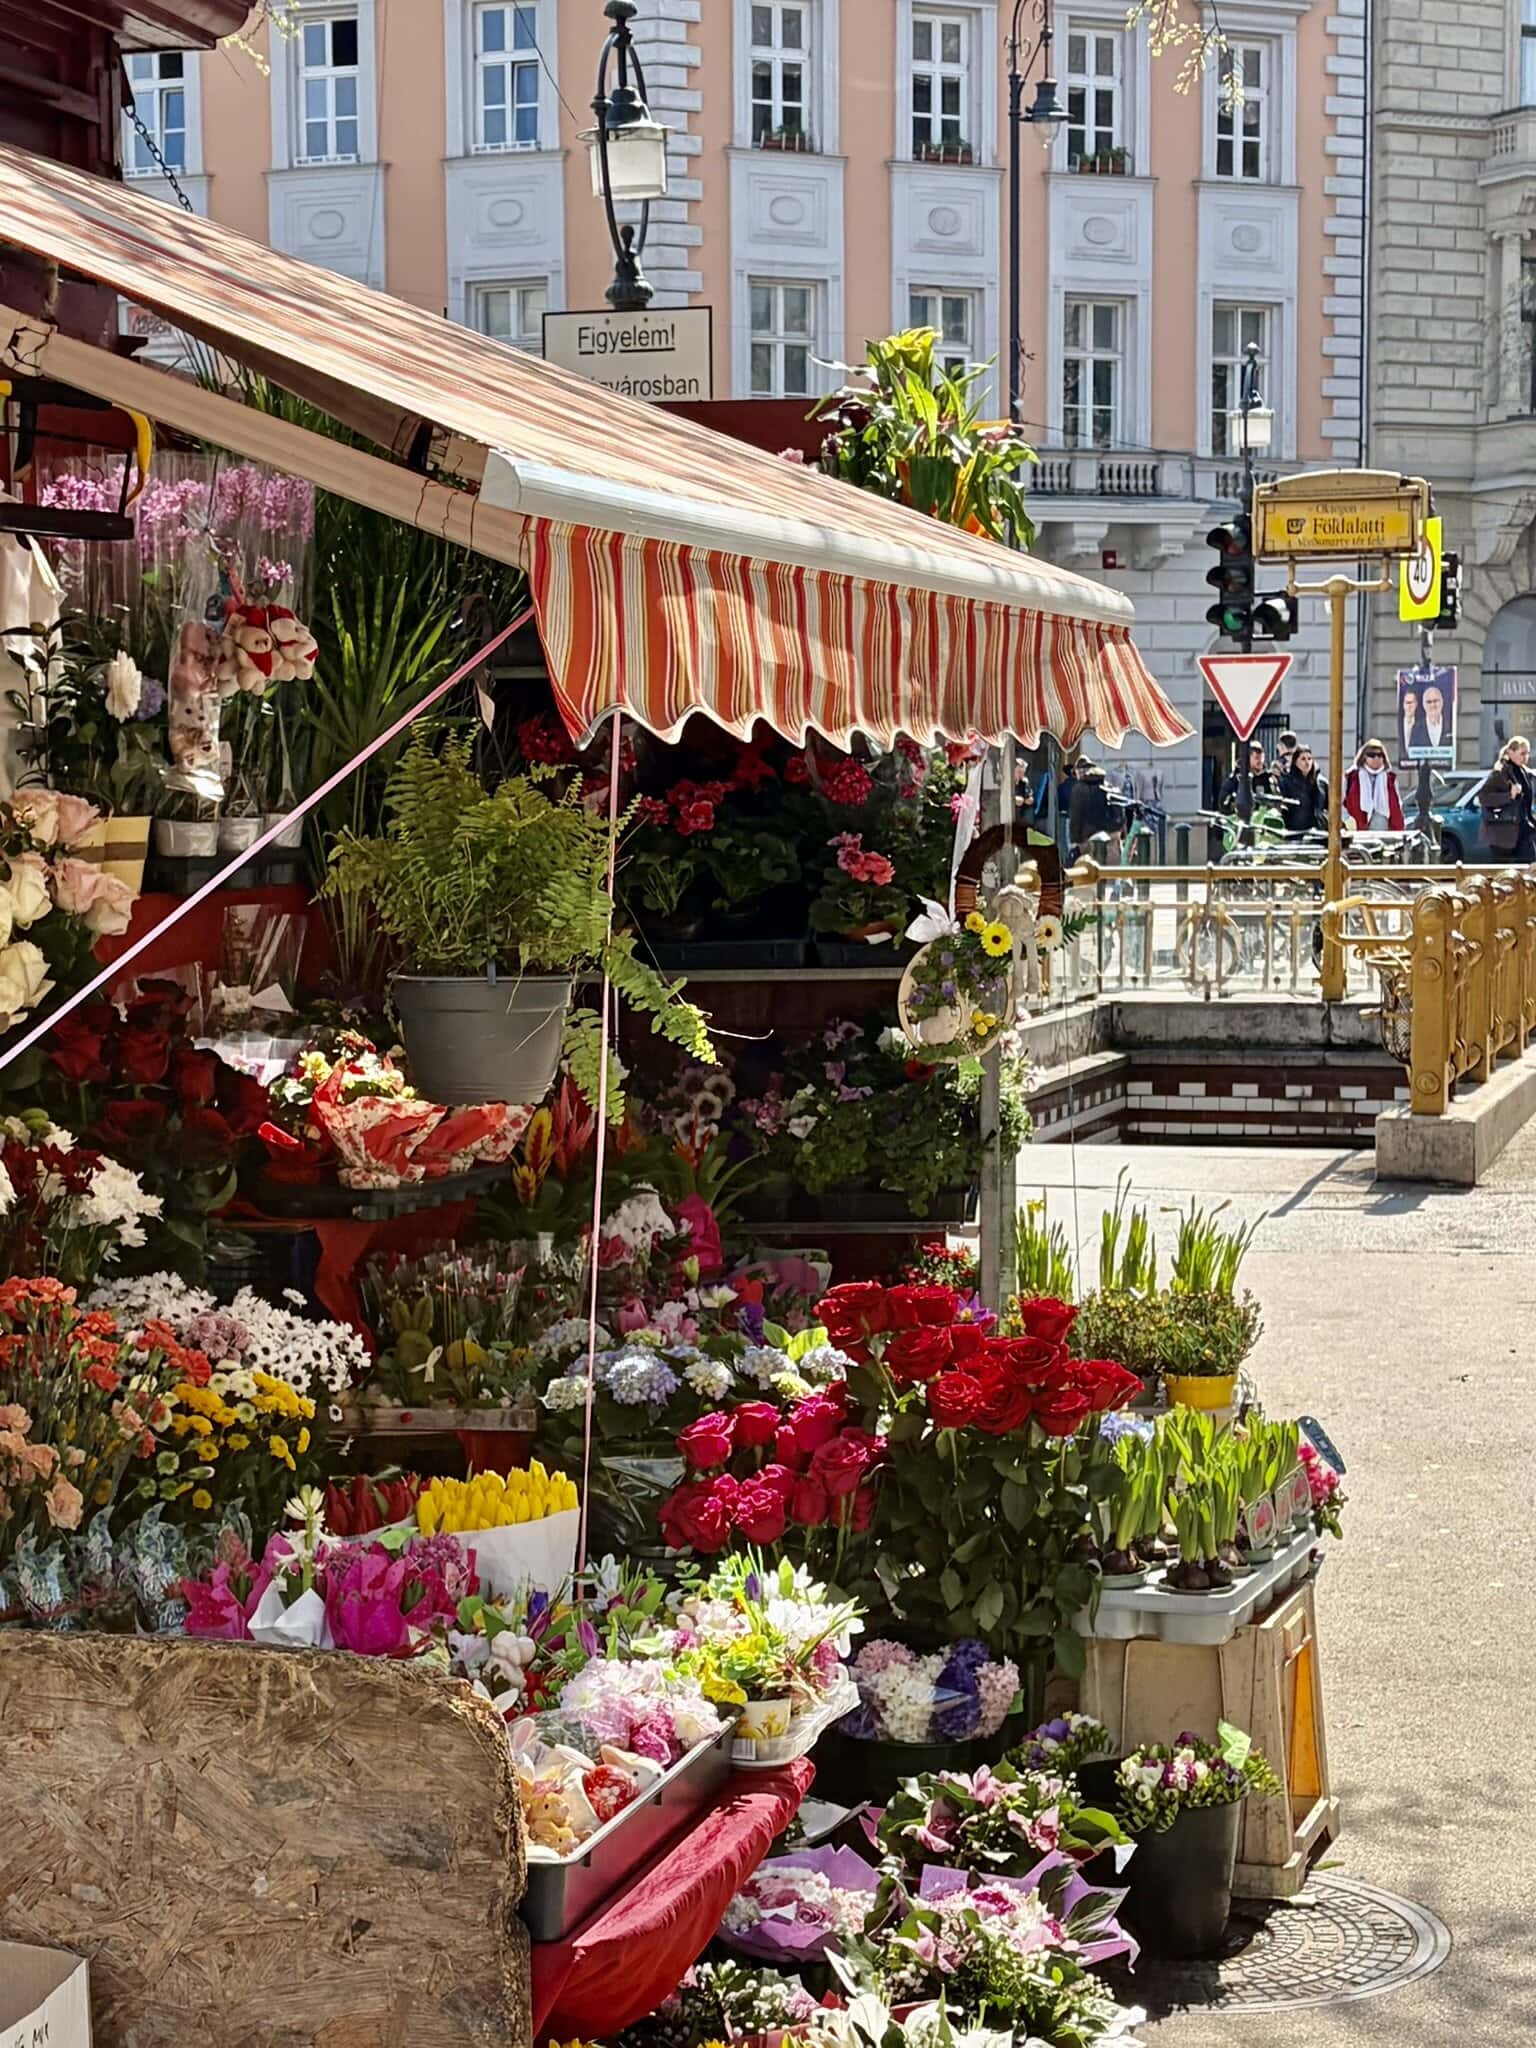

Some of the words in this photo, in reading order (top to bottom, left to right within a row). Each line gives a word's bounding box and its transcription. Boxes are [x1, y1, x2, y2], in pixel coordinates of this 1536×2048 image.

[578, 324, 676, 353] Figyelem!
[590, 374, 699, 396] városban
[1313, 517, 1385, 535] Földalatti
[1413, 557, 1428, 584] 40
